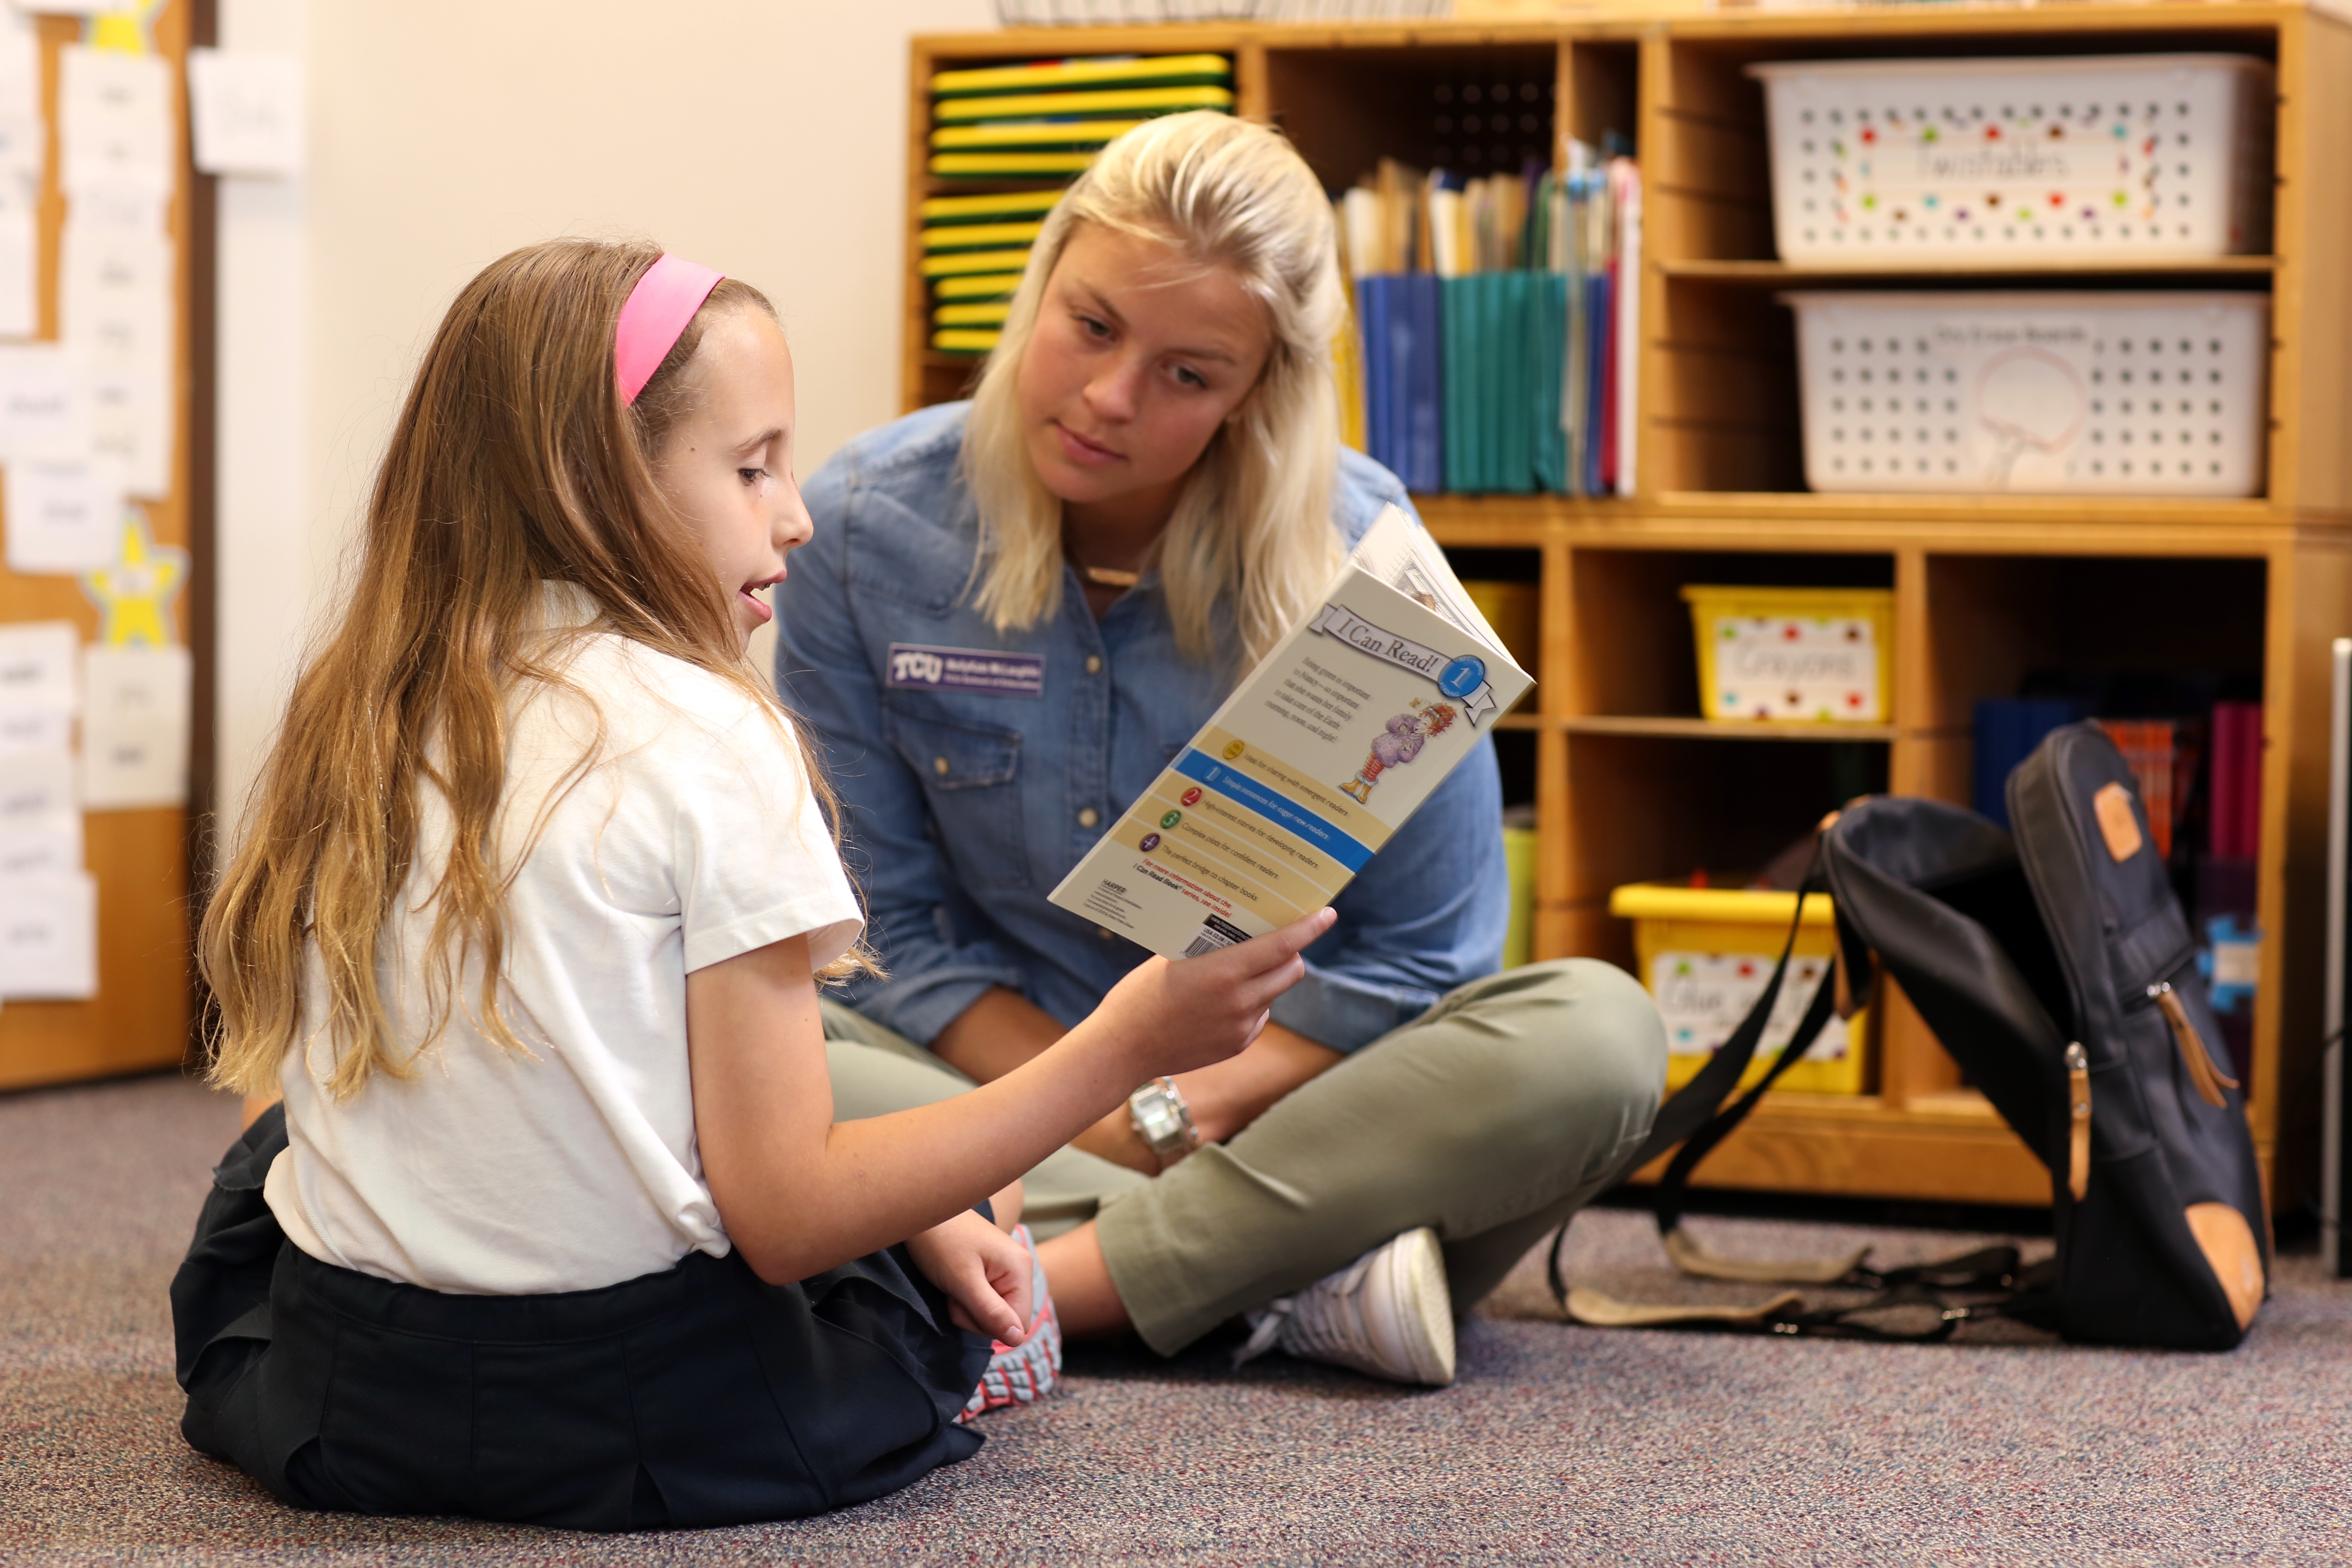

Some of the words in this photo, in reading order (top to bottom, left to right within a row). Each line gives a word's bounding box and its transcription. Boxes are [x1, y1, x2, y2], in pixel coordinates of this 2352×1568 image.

[1337, 618, 1353, 634] I
[1350, 625, 1382, 652] Can
[1383, 639, 1439, 672] Read!
[893, 652, 943, 684] TCU
[1302, 656, 1320, 672] Being
[1318, 668, 1336, 681] green
[1342, 678, 1371, 699] important
[1450, 667, 1470, 688] 1
[1459, 657, 1483, 675] BEGINNING
[1283, 679, 1296, 688] that
[1294, 684, 1306, 695] she
[1307, 691, 1323, 704] wants
[1323, 699, 1333, 710] her
[1333, 706, 1353, 721] family
[1330, 690, 1359, 709] important
[1440, 682, 1459, 696] READING
[1281, 693, 1294, 704] take
[1293, 701, 1306, 710] care
[1313, 710, 1323, 720] the
[1323, 715, 1340, 729] Earth
[1307, 724, 1320, 733] and
[1318, 730, 1338, 742] night!
[1206, 767, 1218, 780] 1
[1244, 753, 1258, 764] Ideal
[1258, 760, 1267, 768] for
[1266, 766, 1287, 781] sharing
[1287, 777, 1299, 787] with
[1300, 785, 1326, 803] emergent
[1326, 800, 1348, 816] readers
[1183, 789, 1198, 804] 2
[1223, 776, 1241, 790] Simple
[1241, 788, 1268, 804] sentences
[1267, 801, 1278, 809] for
[1278, 807, 1294, 818] eager
[1293, 816, 1306, 825] new
[1306, 823, 1329, 839] readers
[1163, 812, 1177, 825] 3
[1203, 799, 1236, 821] High-interest
[1237, 819, 1256, 832] stories
[1256, 828, 1266, 836] for
[1266, 835, 1296, 855] developing
[1296, 852, 1319, 869] readers
[1144, 835, 1157, 849] 4
[1182, 822, 1206, 839] Complex
[1205, 836, 1221, 846] plots
[1221, 843, 1230, 851] for
[1230, 849, 1256, 866] confident
[1256, 864, 1279, 879] readers
[1101, 879, 1126, 893] HARPER
[1142, 858, 1154, 866] For
[1153, 864, 1169, 875] more
[1169, 871, 1203, 893] information
[1203, 891, 1221, 902] about
[1221, 900, 1232, 909] the
[1161, 844, 1172, 855] The
[1171, 853, 1192, 865] perfect
[1192, 861, 1210, 874] bridge
[1218, 876, 1240, 891] chapter
[1240, 886, 1258, 901] books
[1136, 865, 1148, 874] Can
[1148, 871, 1164, 882] Read
[1181, 889, 1199, 902] series,
[1200, 898, 1212, 907] see
[1211, 904, 1232, 918] inside!
[1203, 927, 1213, 935] USA
[1212, 933, 1225, 942] $3.99
